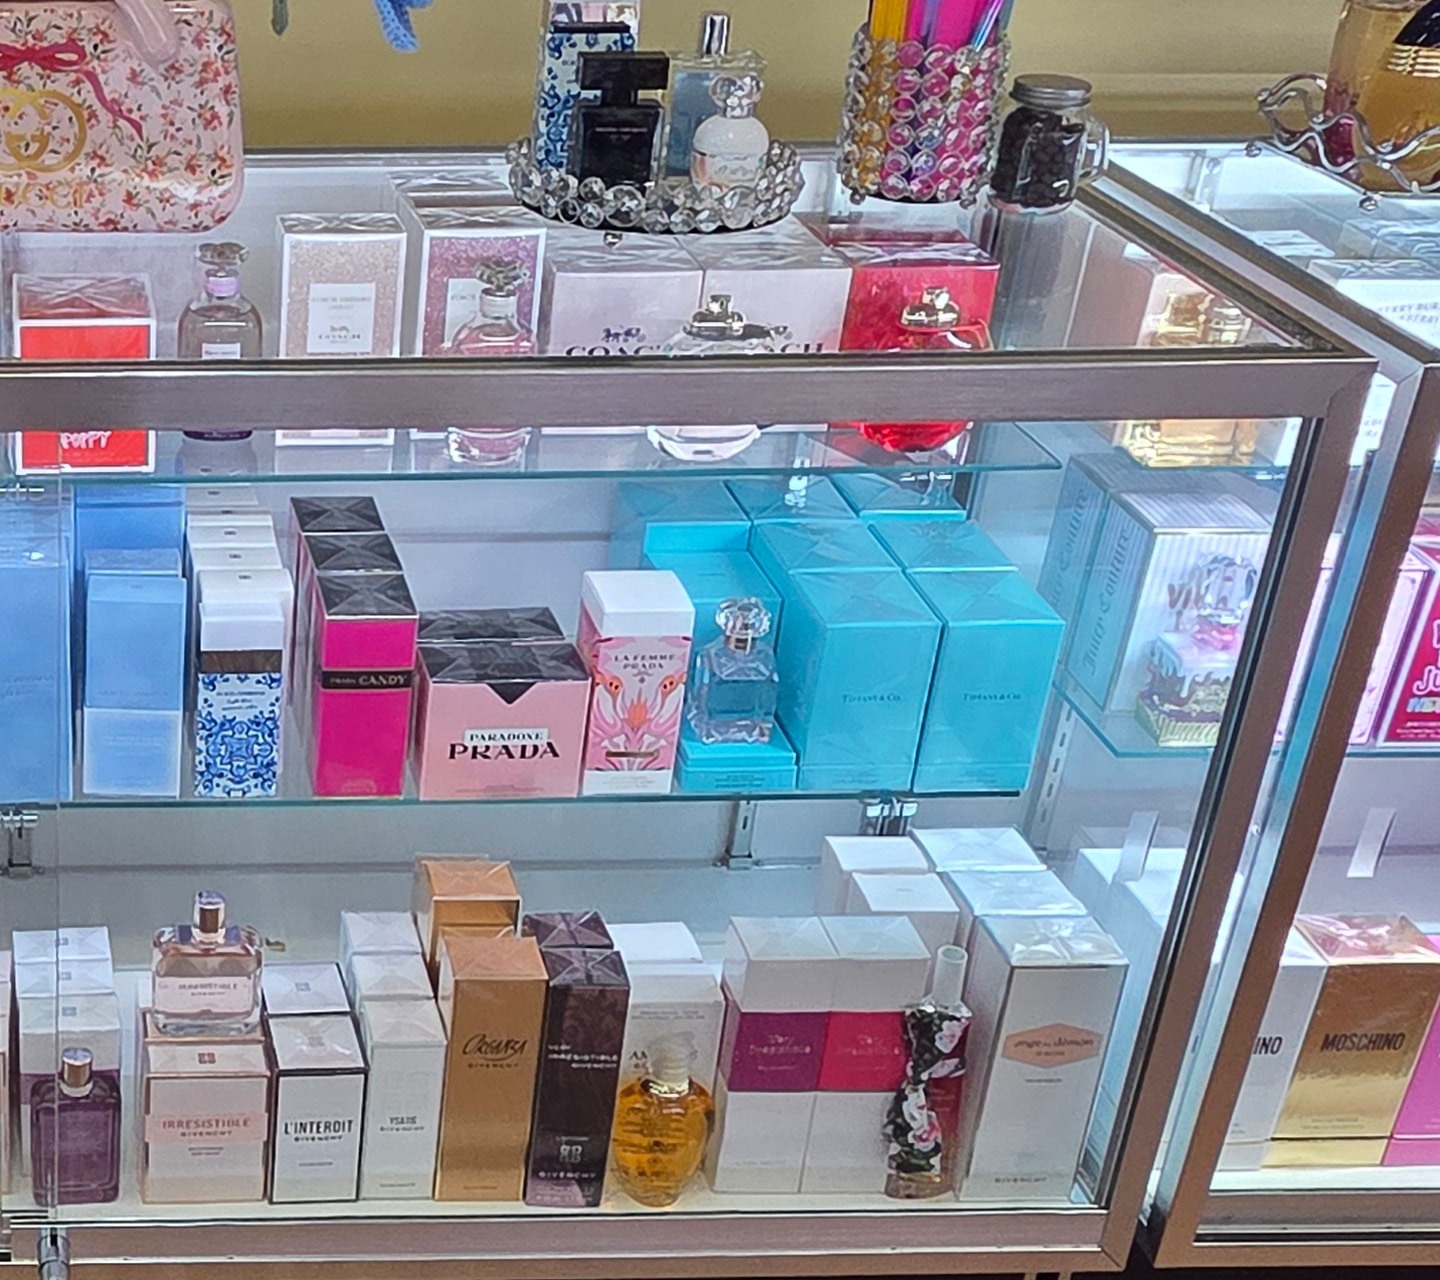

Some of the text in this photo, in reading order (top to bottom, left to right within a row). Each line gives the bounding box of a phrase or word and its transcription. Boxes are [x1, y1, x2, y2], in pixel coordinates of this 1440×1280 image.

[358, 674, 408, 686] CANDY
[448, 741, 561, 760] PRADA
[1319, 1032, 1406, 1053] MOSCHINO
